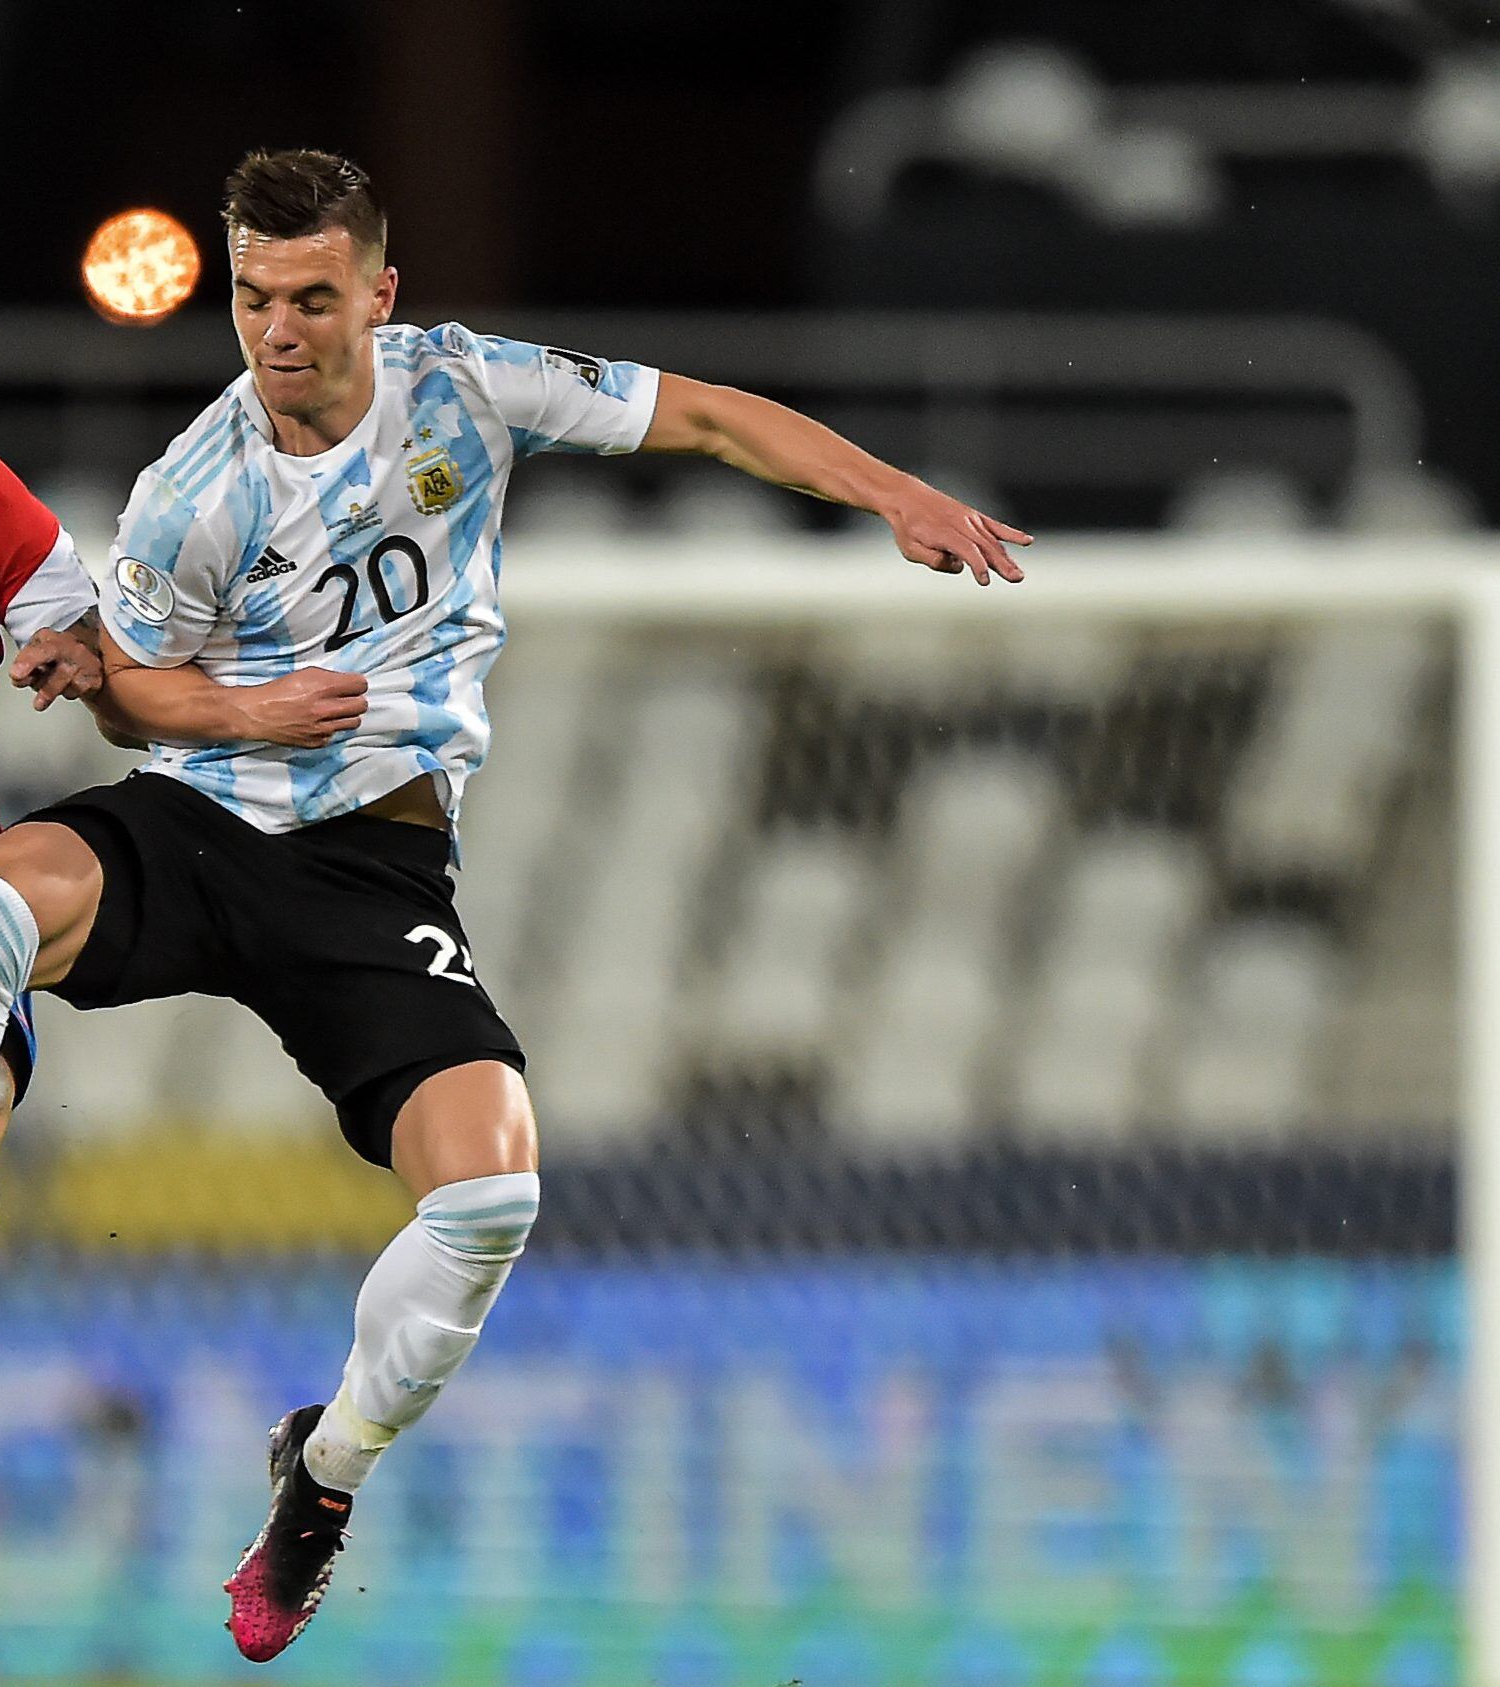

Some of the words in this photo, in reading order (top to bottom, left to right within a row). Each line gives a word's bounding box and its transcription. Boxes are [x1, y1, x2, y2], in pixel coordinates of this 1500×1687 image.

[421, 467, 452, 497] AFA
[246, 561, 297, 584] adidas
[311, 534, 429, 653] 20
[403, 924, 476, 987] 2
